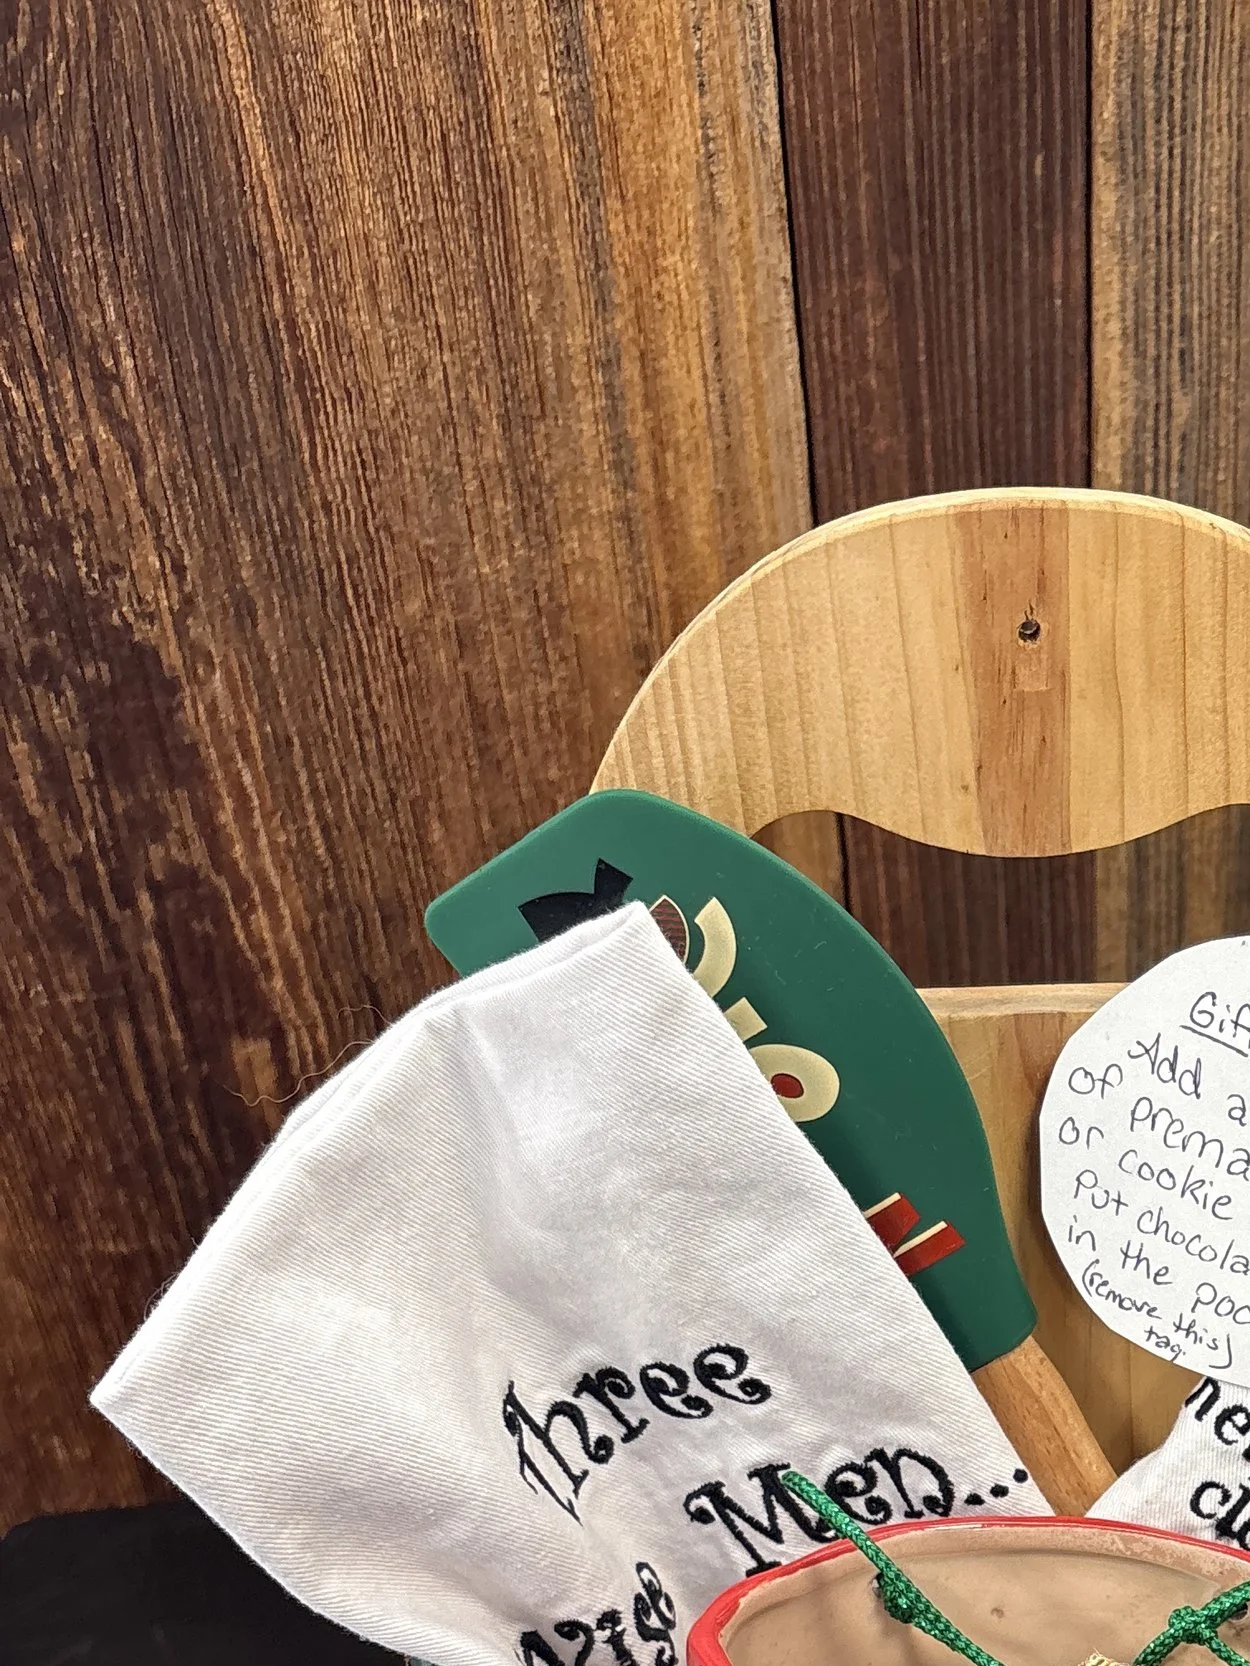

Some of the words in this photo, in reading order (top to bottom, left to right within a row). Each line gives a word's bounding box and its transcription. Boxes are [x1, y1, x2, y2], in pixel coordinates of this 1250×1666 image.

[1127, 1033, 1202, 1099] Add
[1227, 1094, 1247, 1127] a
[1068, 1215, 1096, 1251] in
[1120, 1240, 1173, 1286] the
